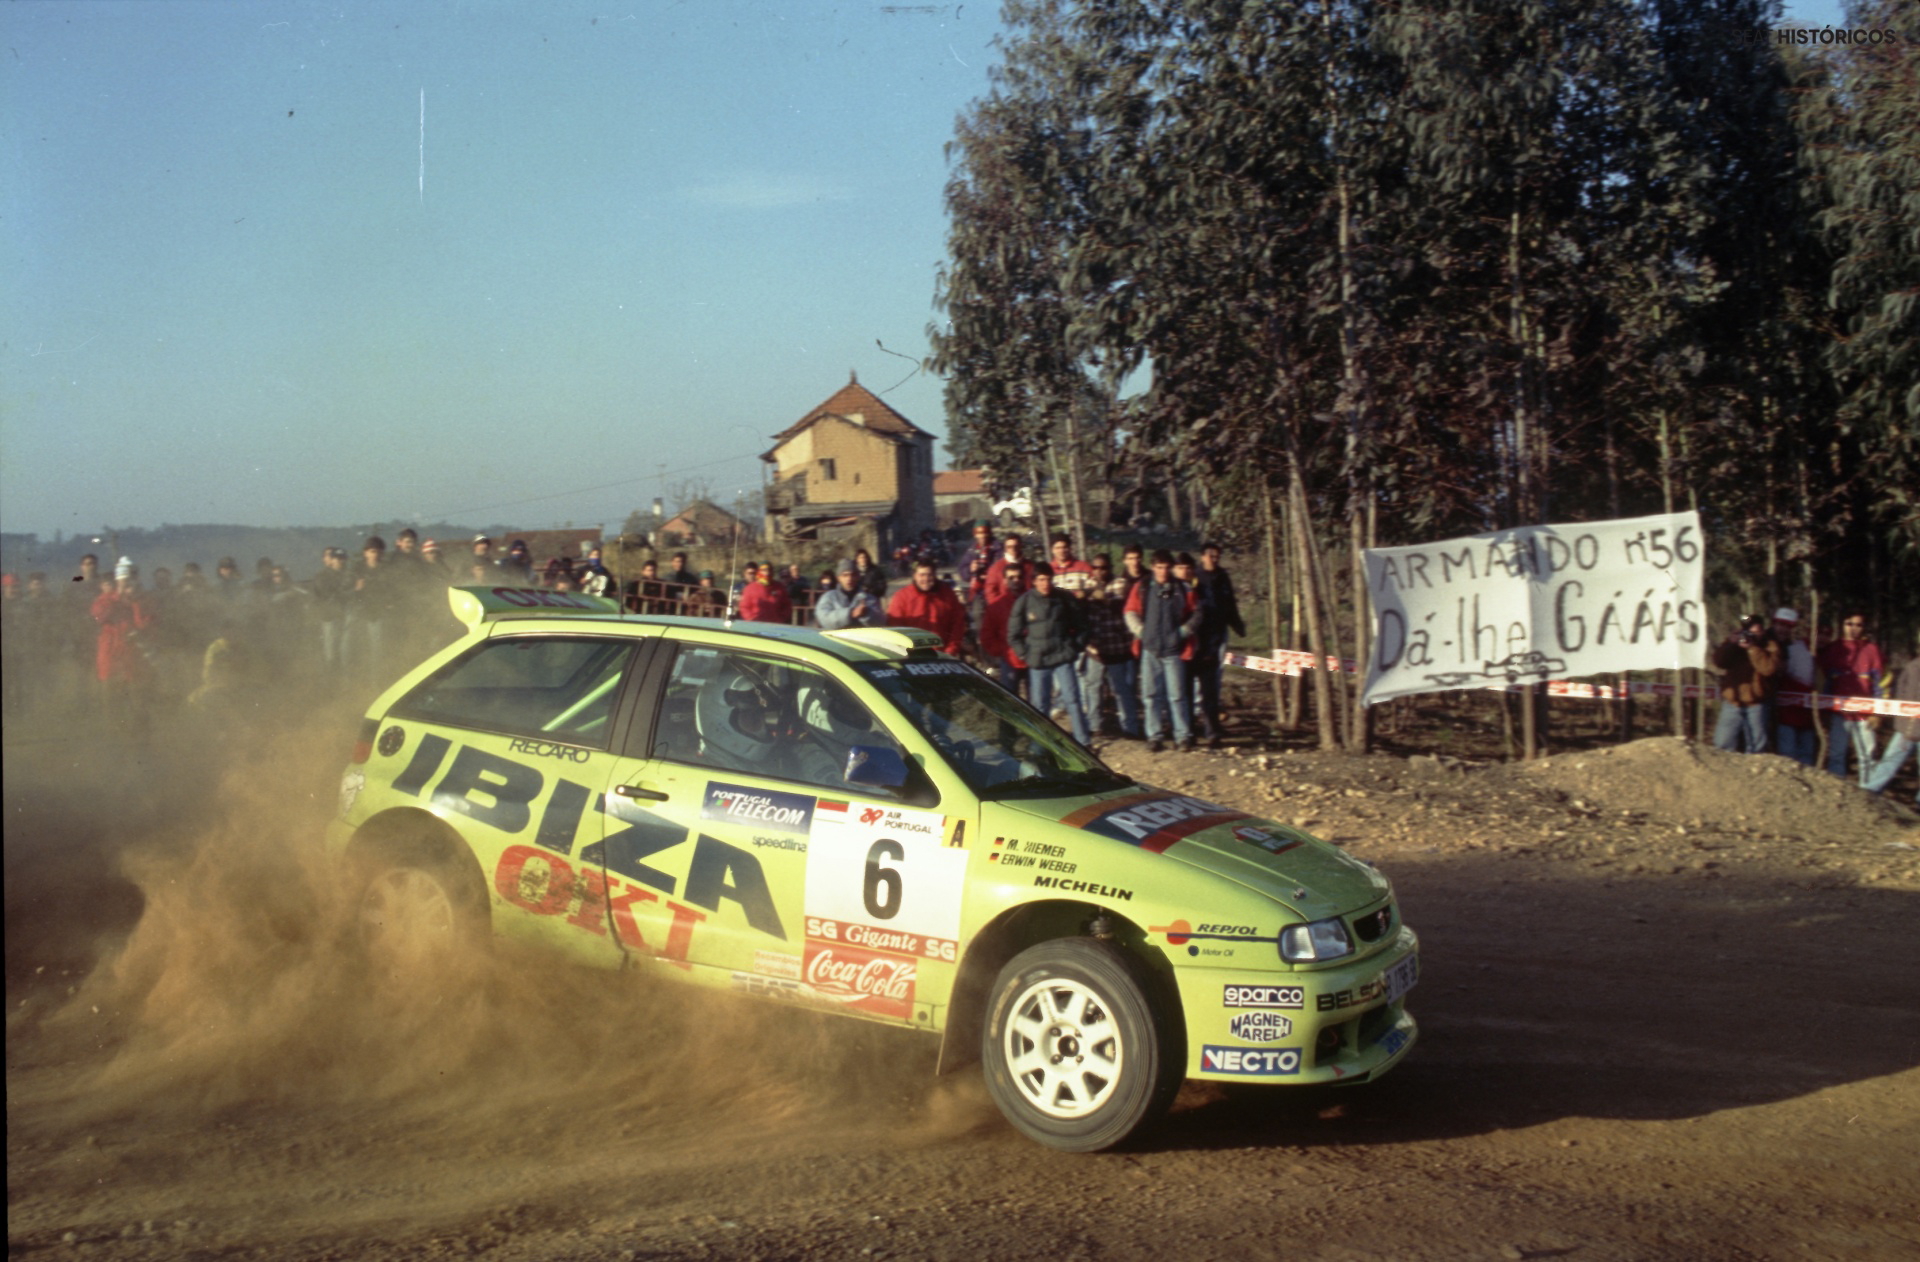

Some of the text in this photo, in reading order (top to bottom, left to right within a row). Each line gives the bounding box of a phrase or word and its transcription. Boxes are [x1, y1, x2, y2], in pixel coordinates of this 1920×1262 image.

[1379, 533, 1600, 592] ARMANDO
[1377, 592, 1527, 672] Dá-lhe
[509, 737, 590, 764] RECARO
[725, 793, 806, 826] TELECOM
[886, 810, 902, 820] AIR
[390, 732, 788, 942] IBIZA
[884, 819, 932, 834] PORTUGAL
[1006, 838, 1020, 852] M.
[1000, 853, 1078, 875] ERWIN WEBER
[862, 838, 905, 921] 6
[1033, 875, 1134, 901] MICHELIN
[494, 844, 706, 972] OKI
[807, 918, 956, 962] SG Gigante SG
[1197, 923, 1259, 936] REPSOL
[807, 949, 916, 999] Coca-Cola
[1225, 986, 1303, 1007] sparco
